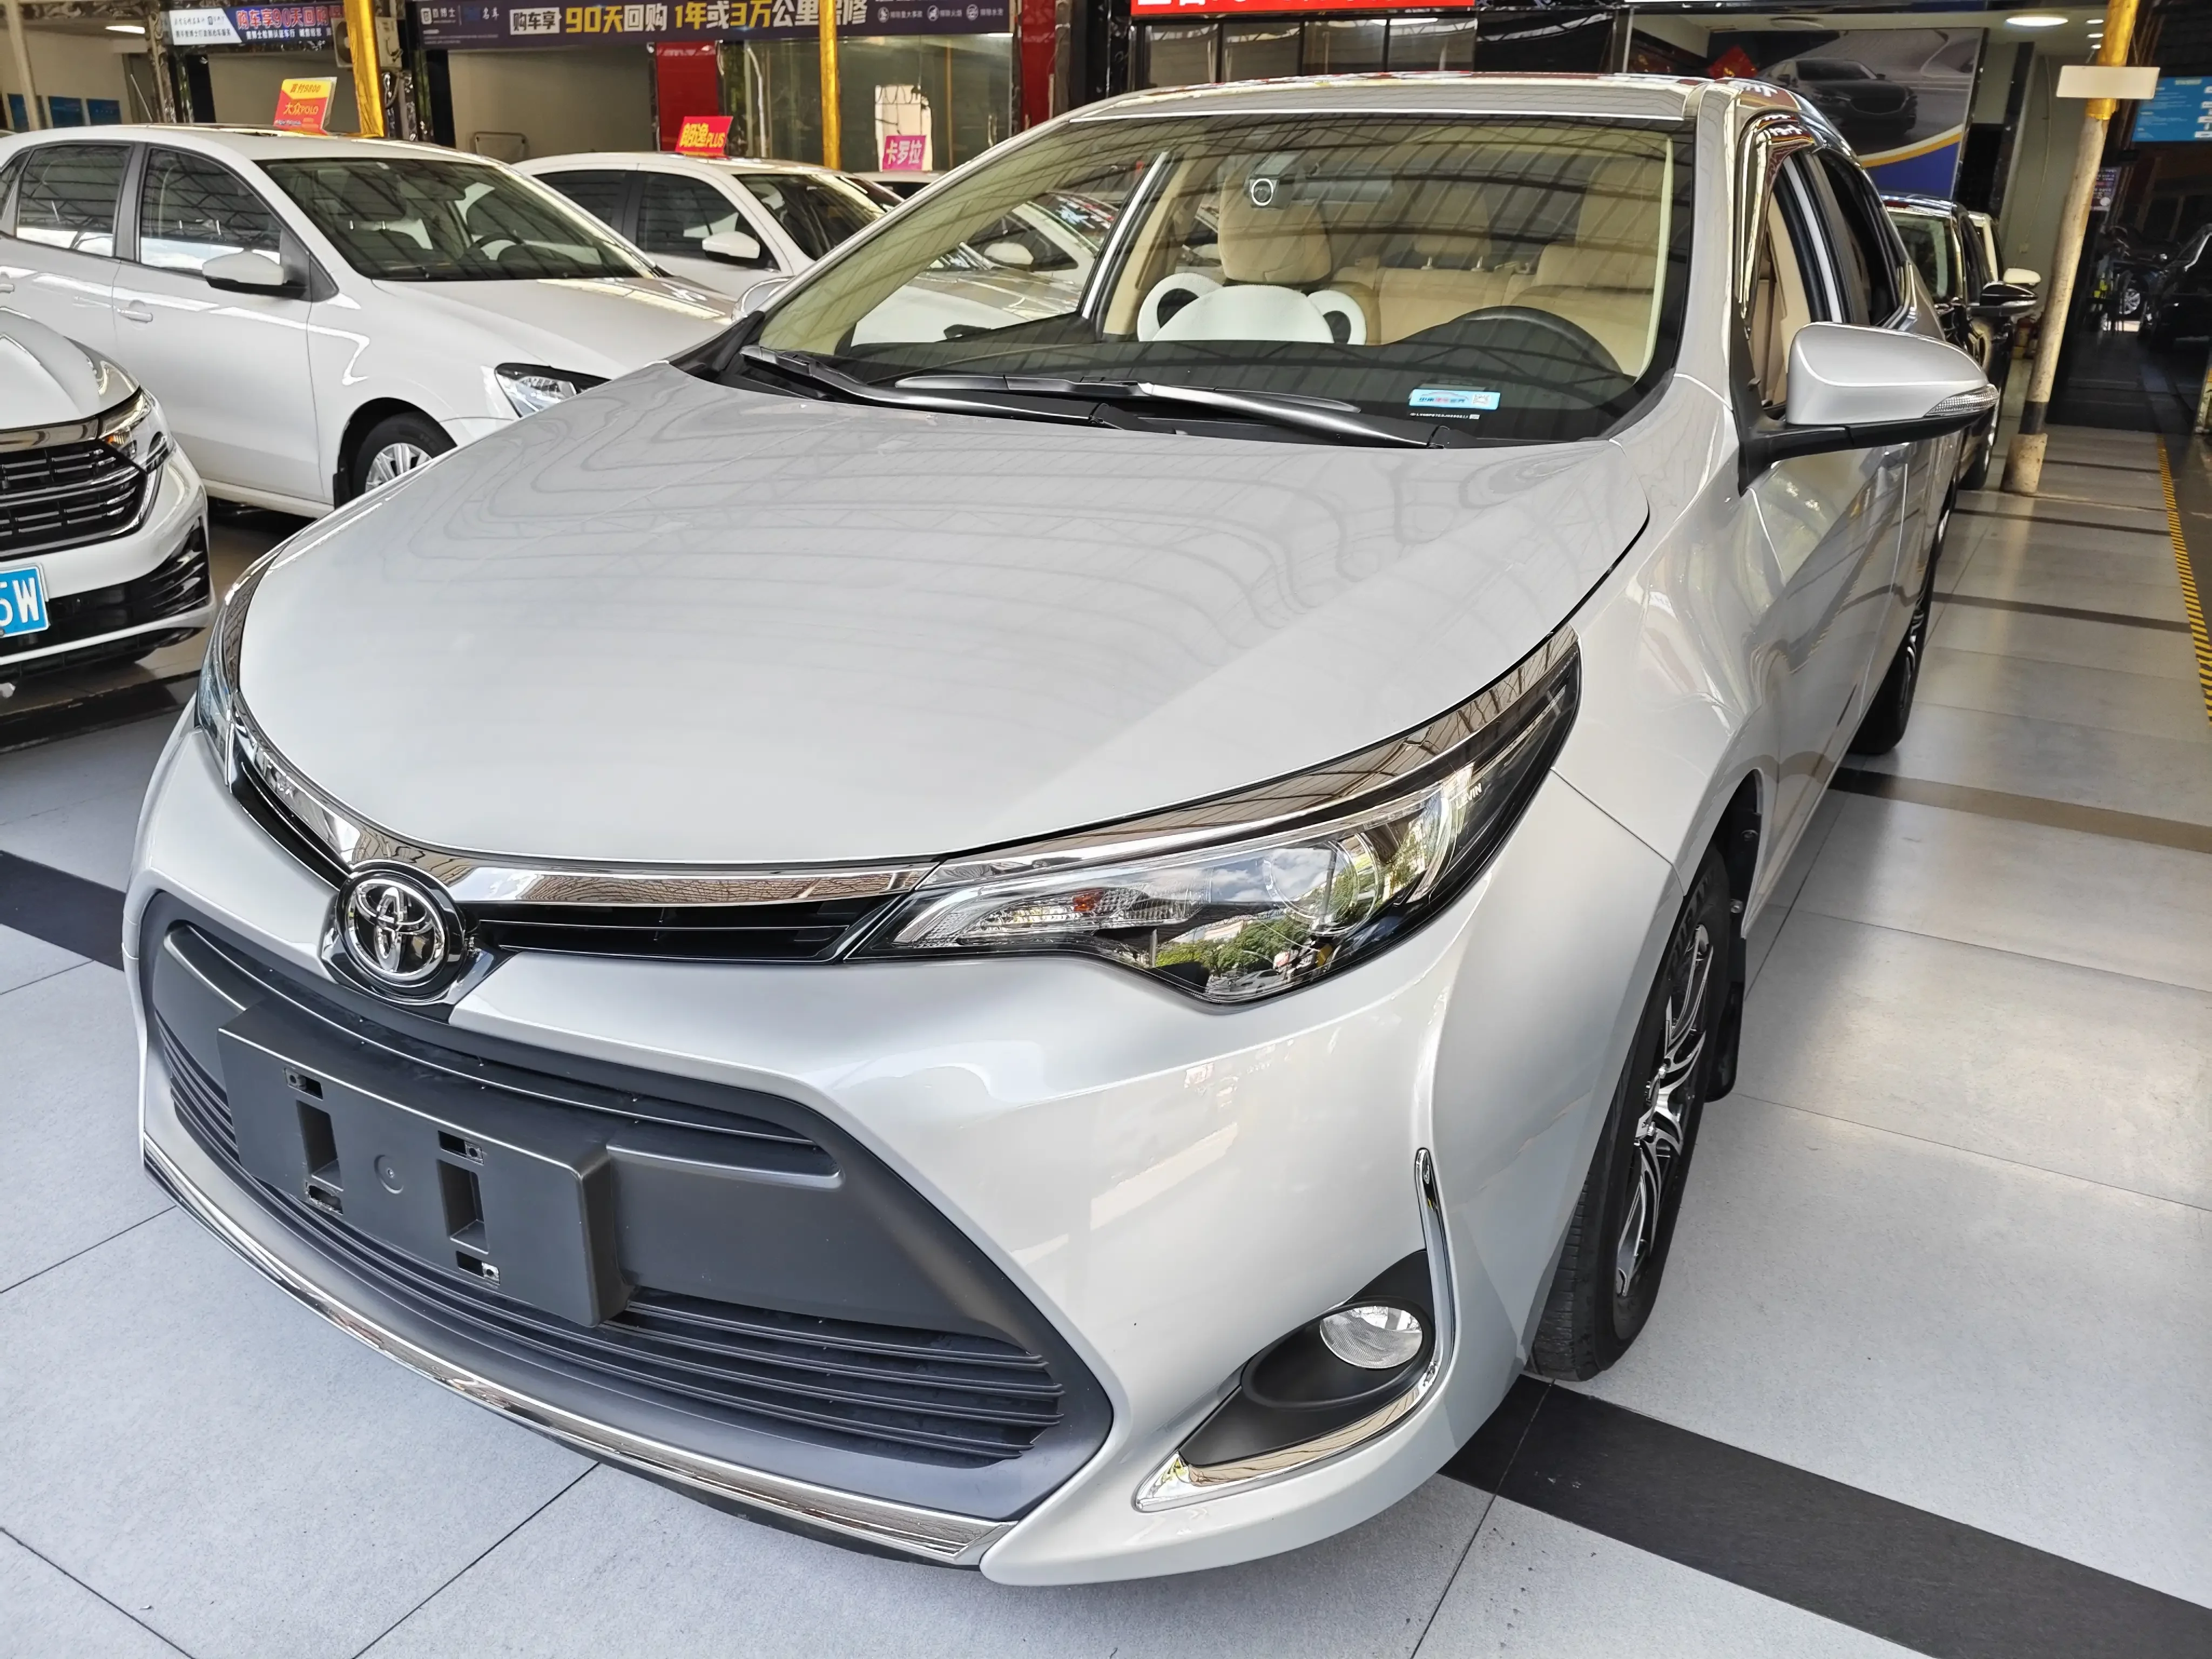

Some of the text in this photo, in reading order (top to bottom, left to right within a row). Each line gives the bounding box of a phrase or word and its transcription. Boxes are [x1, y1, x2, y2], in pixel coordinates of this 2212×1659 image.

[514, 0, 867, 33] 购车享 90天回购 1年或3万公里修
[283, 102, 319, 116] 大众POLO
[886, 139, 922, 165] 卡罗拉
[1457, 783, 1482, 810] LEVIN
